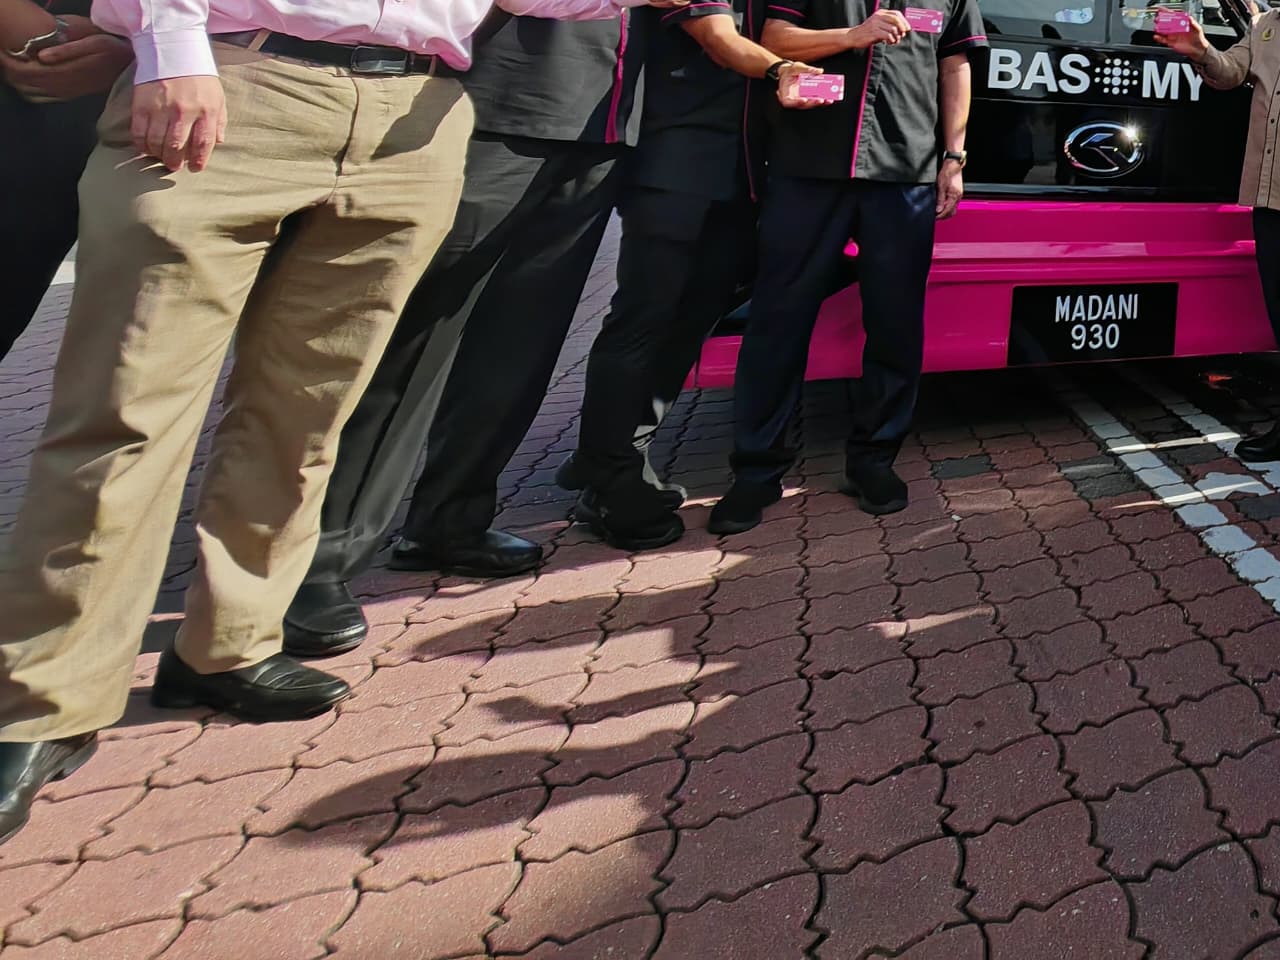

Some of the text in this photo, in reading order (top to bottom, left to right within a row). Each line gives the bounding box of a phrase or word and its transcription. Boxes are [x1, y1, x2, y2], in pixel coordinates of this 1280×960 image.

[988, 48, 1203, 102] BAS MY
[1055, 293, 1139, 322] MADANI
[1071, 323, 1120, 350] 930
